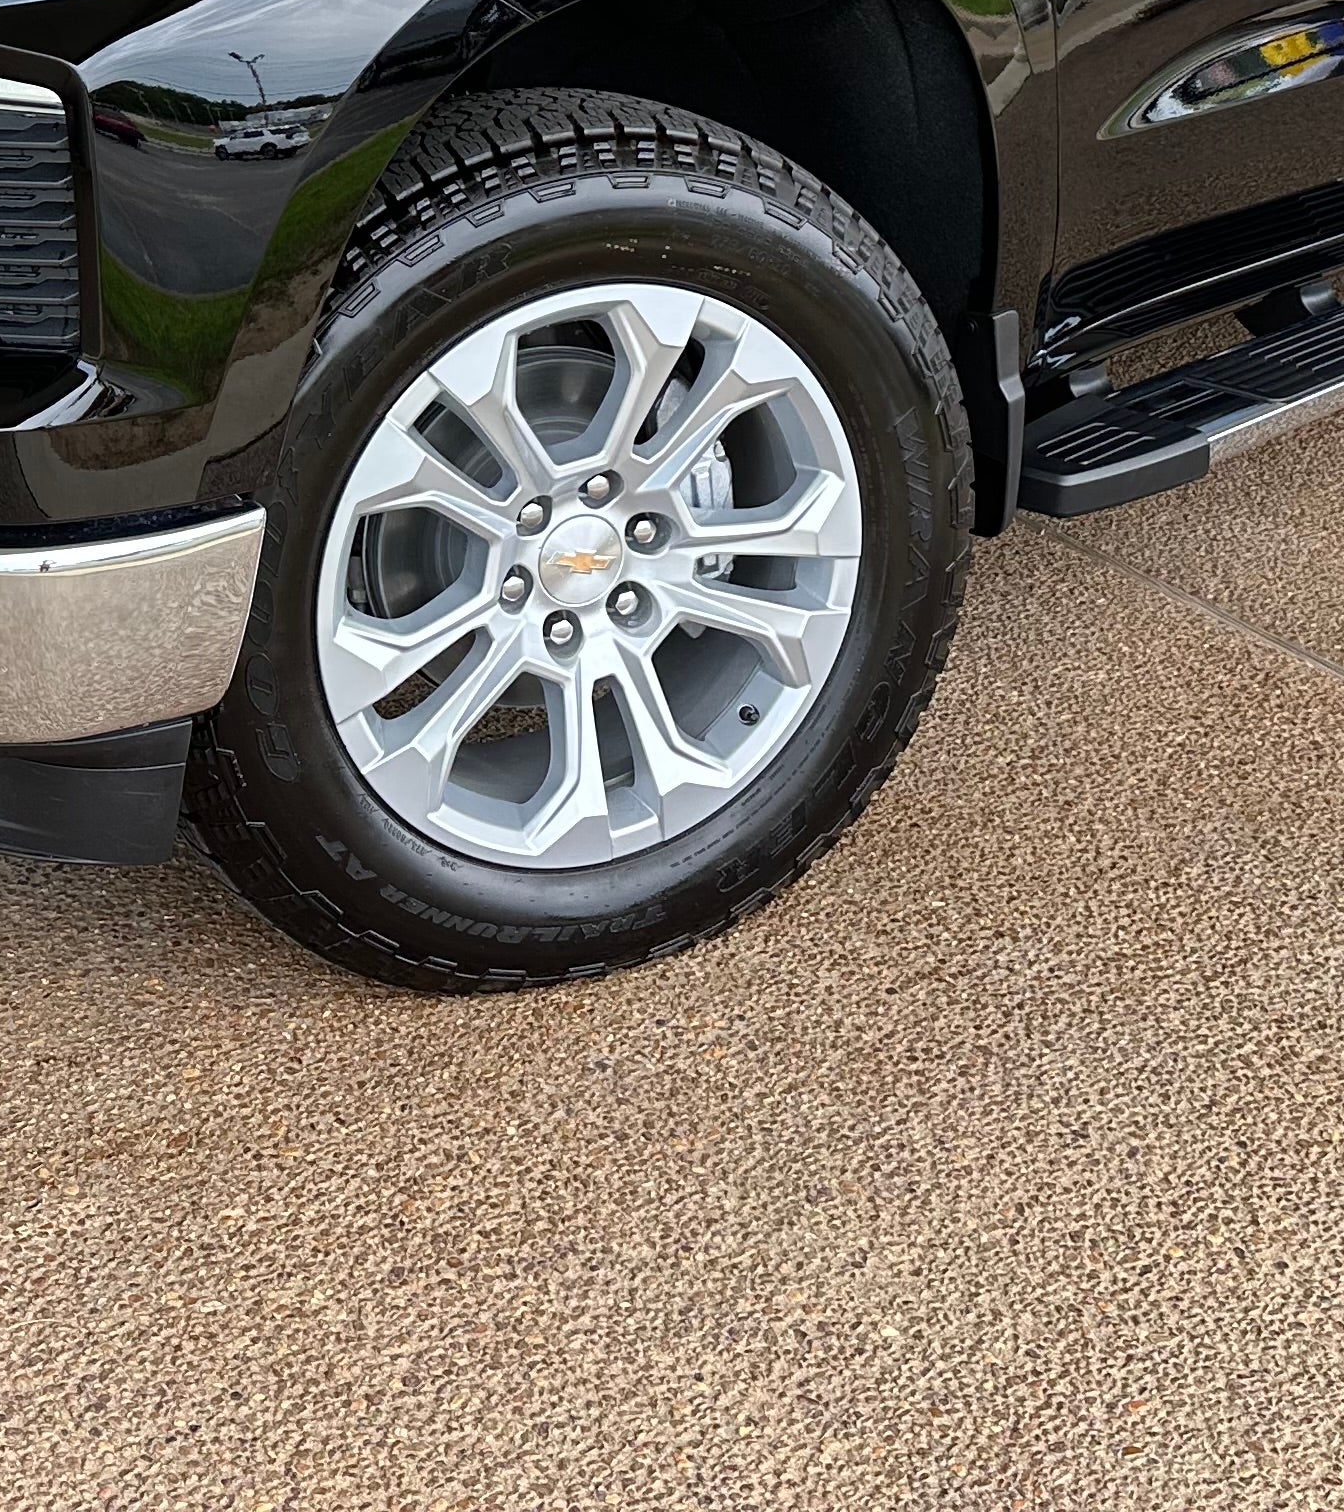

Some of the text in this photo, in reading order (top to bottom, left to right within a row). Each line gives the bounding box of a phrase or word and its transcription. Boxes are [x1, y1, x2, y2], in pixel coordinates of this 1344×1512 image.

[244, 240, 514, 784] GOODYEAR
[716, 406, 936, 894] WRANGLER
[314, 834, 377, 883] AT
[378, 883, 667, 945] TRAILRUNNER
